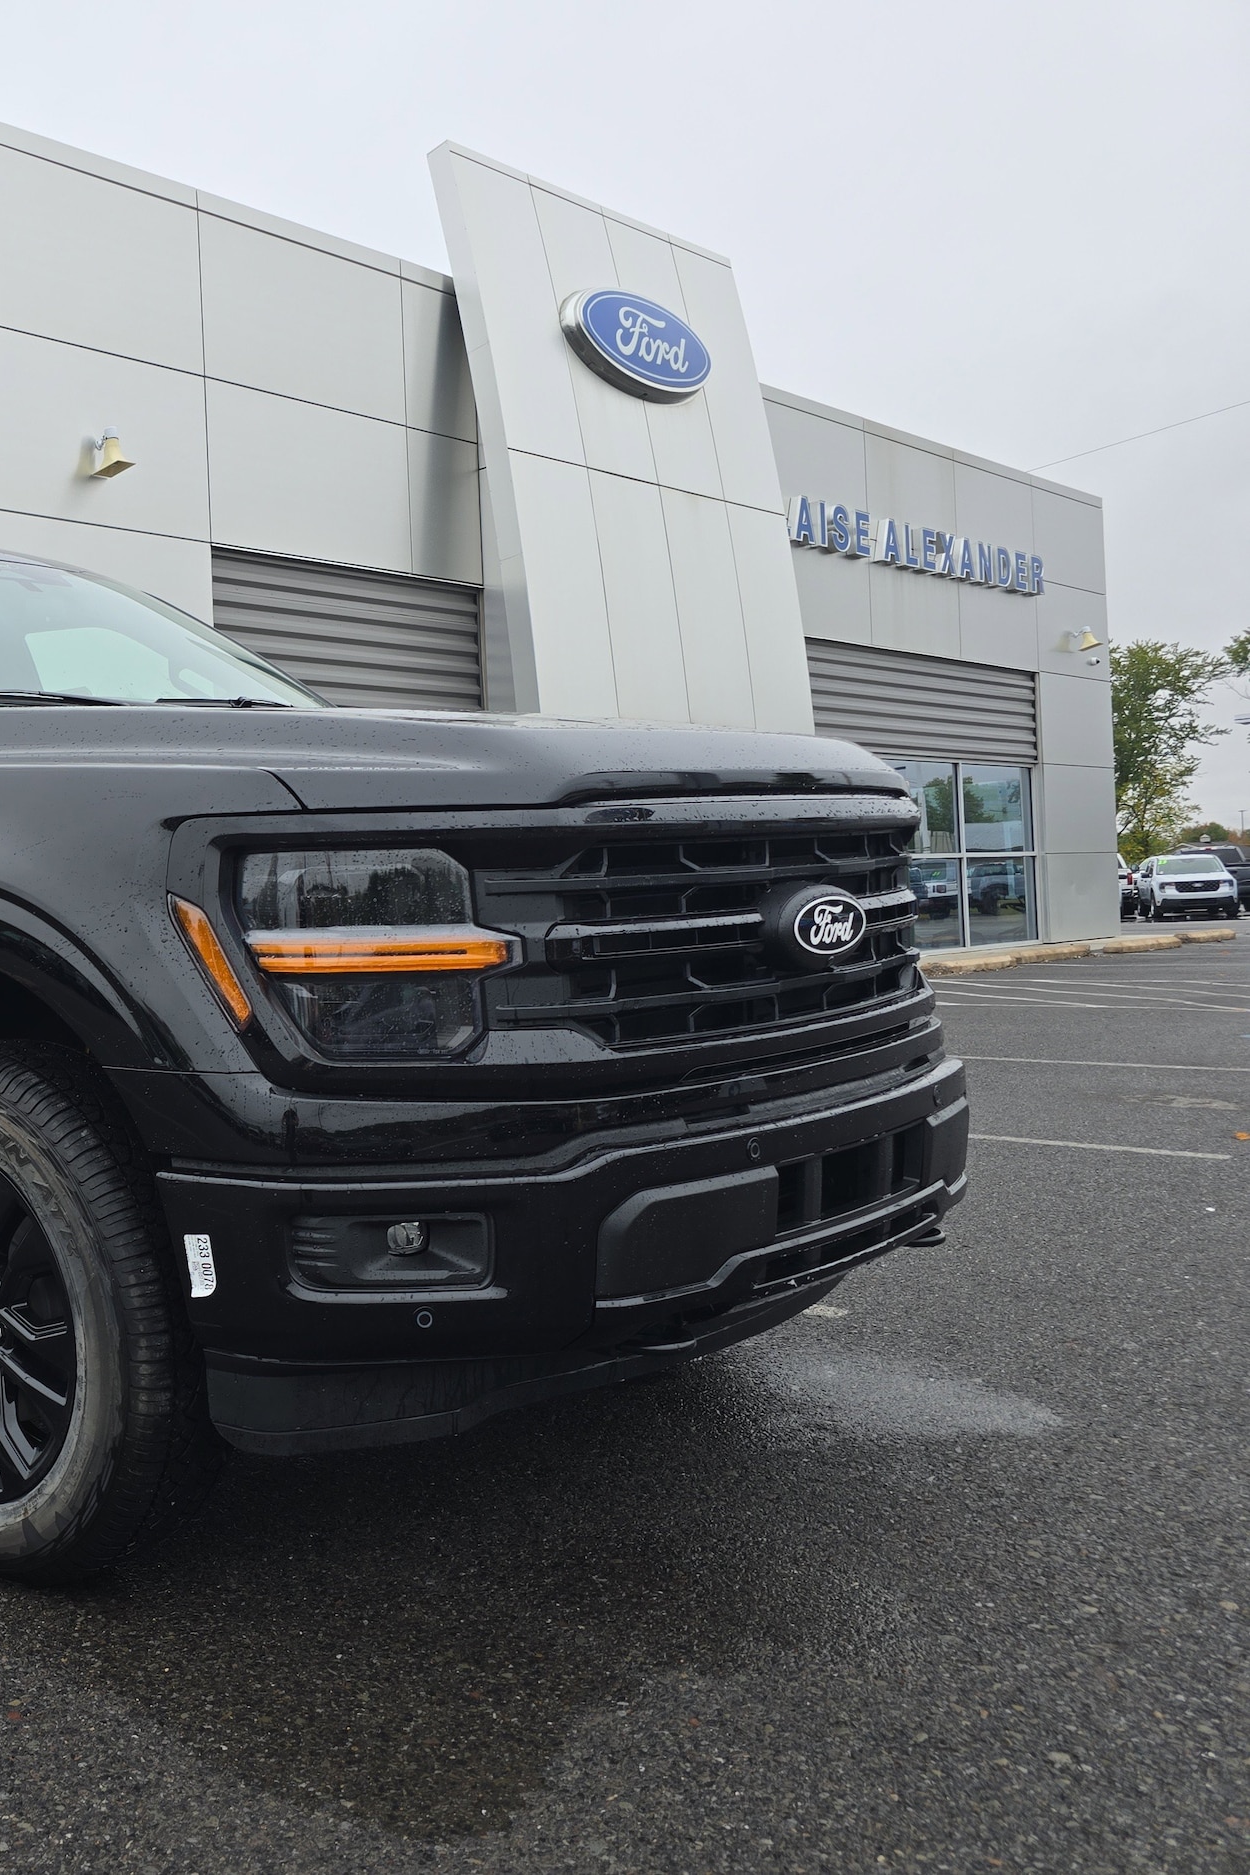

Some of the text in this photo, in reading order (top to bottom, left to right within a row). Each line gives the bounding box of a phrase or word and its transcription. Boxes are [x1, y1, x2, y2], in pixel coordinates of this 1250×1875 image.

[615, 306, 689, 374] Ford
[785, 494, 1046, 596] AISE ALEXANDER
[810, 904, 855, 946] Ford
[197, 1237, 210, 1258] 233
